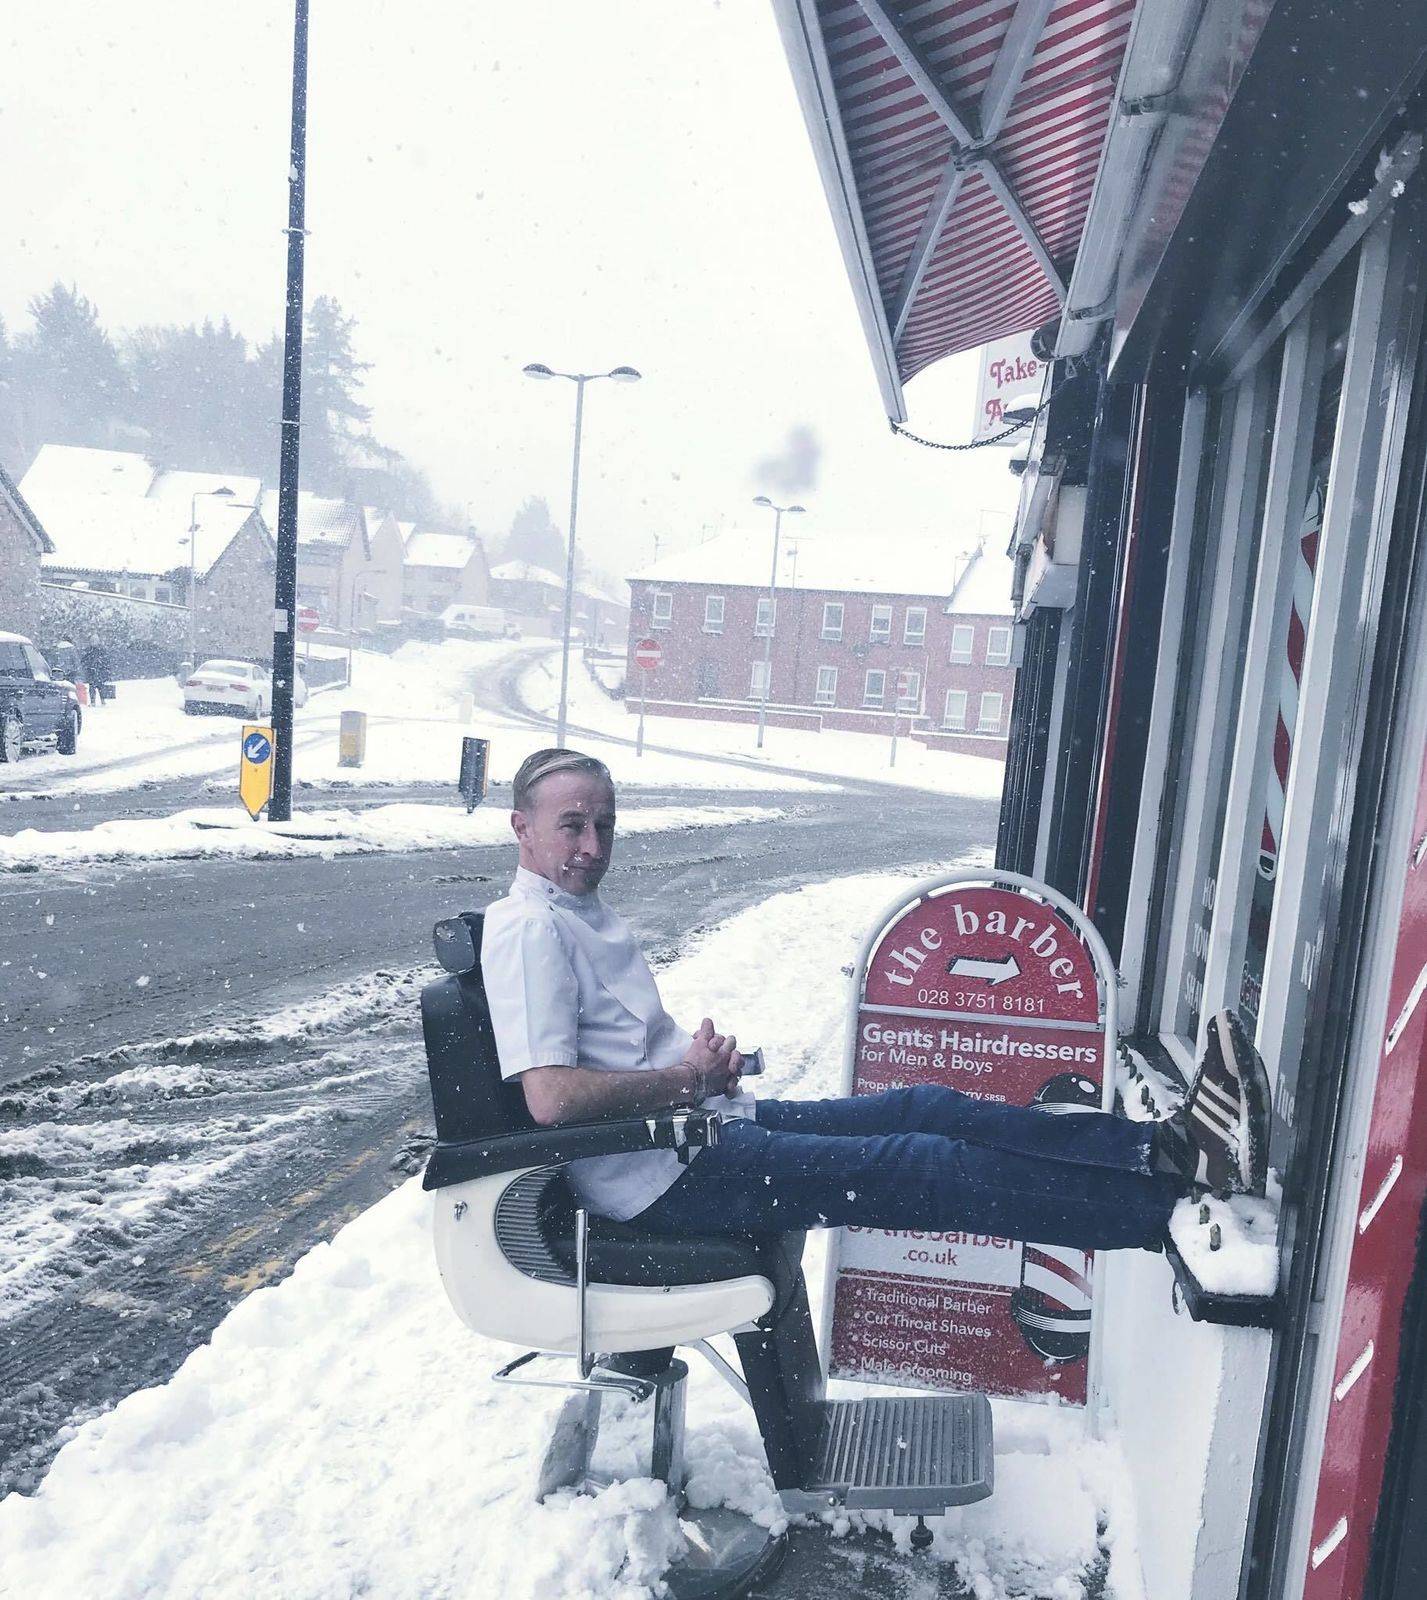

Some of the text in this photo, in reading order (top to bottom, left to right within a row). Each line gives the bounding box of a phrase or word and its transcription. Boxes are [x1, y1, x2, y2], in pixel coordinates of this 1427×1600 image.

[884, 903, 1084, 1000] the barber
[917, 988, 1044, 1012] 028 3751 8181
[862, 1023, 1097, 1063] Gents Hairdressers
[861, 1045, 993, 1076] for Men & Boys
[902, 1248, 958, 1266] .co.uk
[865, 1287, 992, 1315] Traditional Barber
[864, 1310, 992, 1338] Cut Throat Shaves
[861, 1333, 947, 1356] Scissor Cuts
[860, 1356, 973, 1386] Male Grooming
